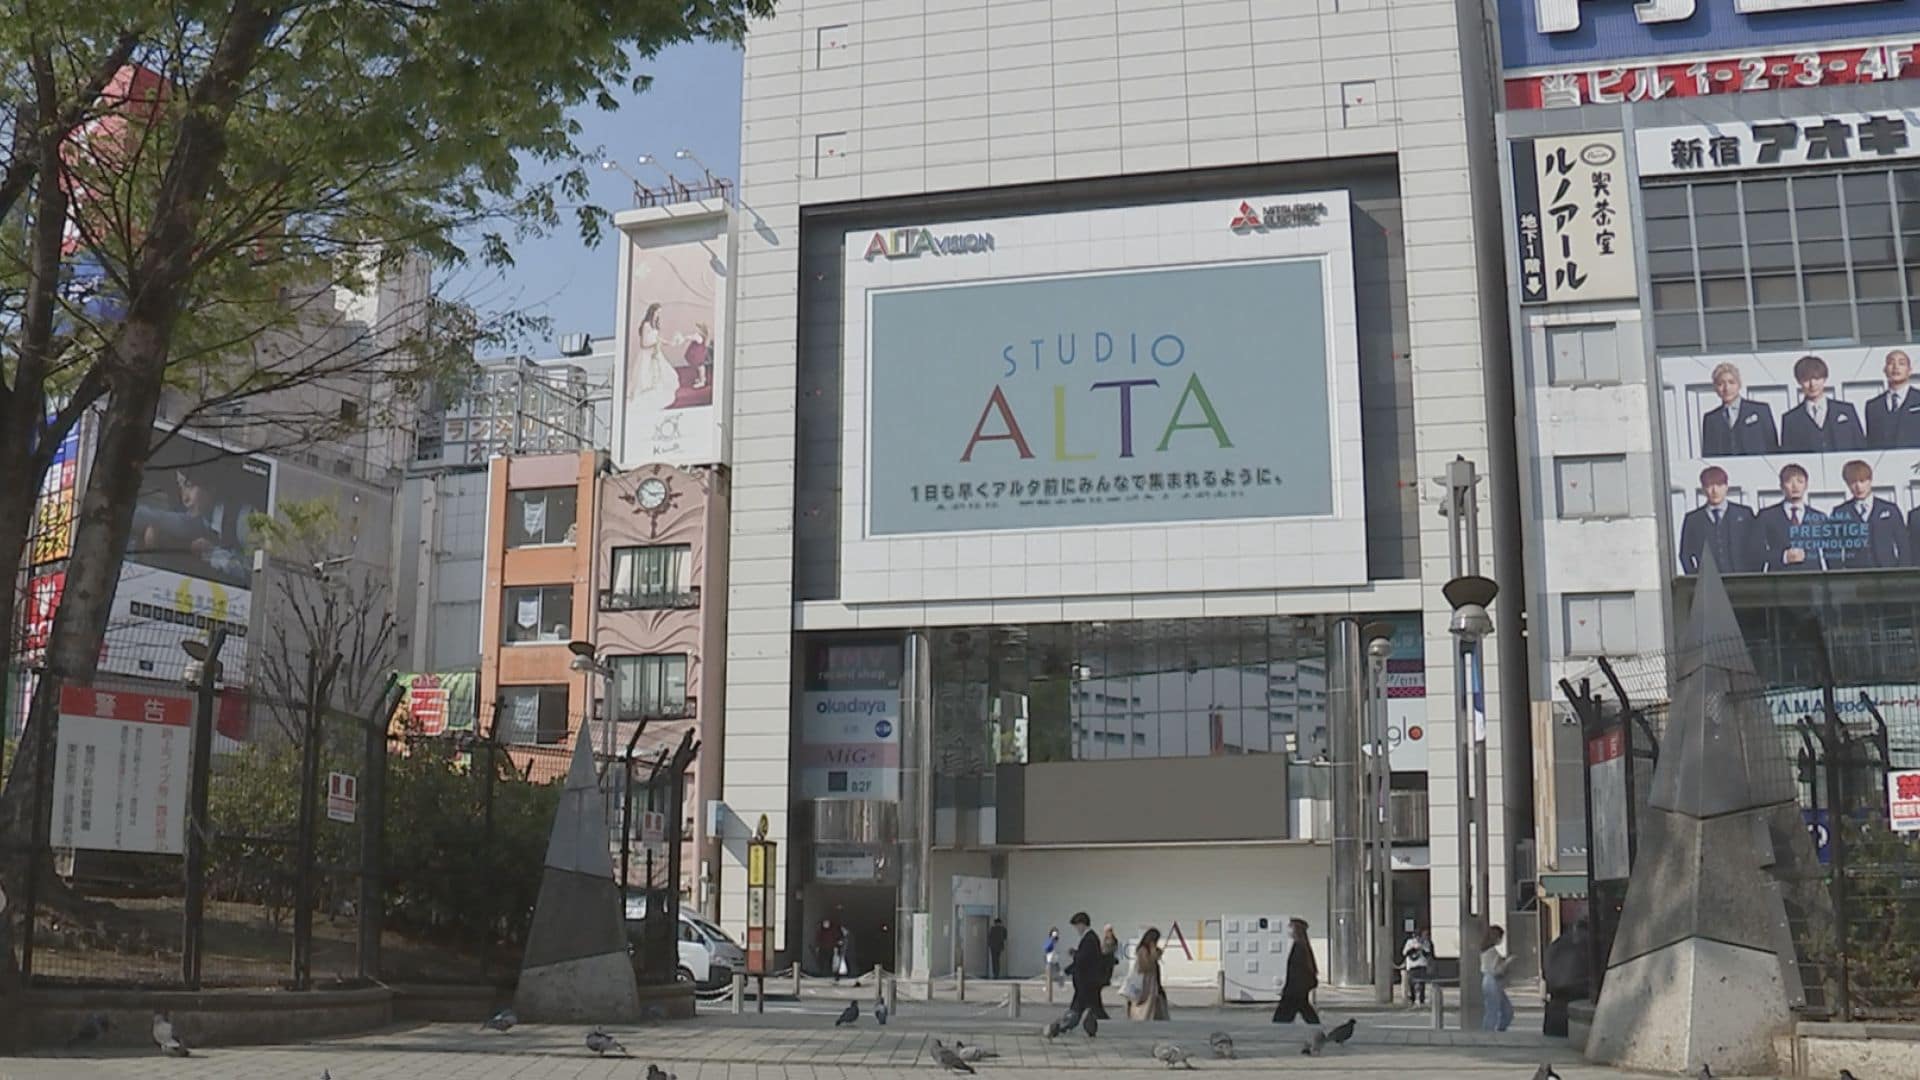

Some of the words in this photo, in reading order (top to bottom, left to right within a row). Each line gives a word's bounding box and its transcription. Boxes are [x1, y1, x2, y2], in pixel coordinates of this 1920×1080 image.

[1671, 115, 1909, 170] 新宿アオキ
[1545, 146, 1588, 290] ルノアール
[1592, 171, 1616, 256] 喫茶室
[1003, 332, 1185, 377] STUDIO
[959, 371, 1235, 462] ALTA
[1789, 523, 1870, 538] PRESTIGE
[1791, 538, 1869, 549] TECHNOLOGY
[817, 697, 886, 716] okadaya
[1386, 716, 1424, 746] glo
